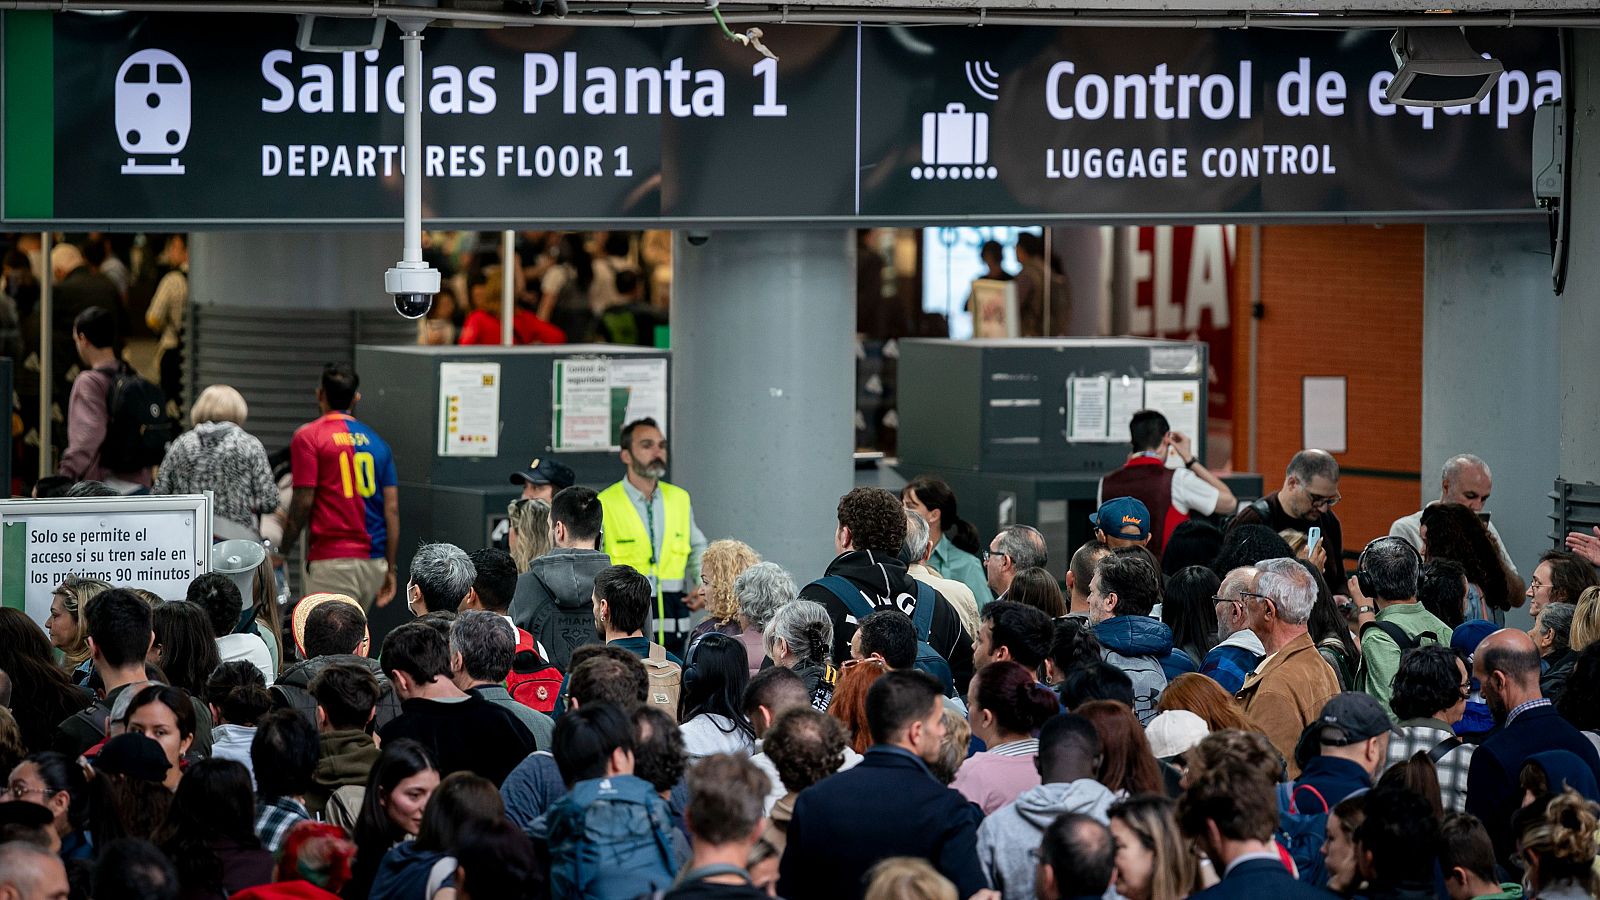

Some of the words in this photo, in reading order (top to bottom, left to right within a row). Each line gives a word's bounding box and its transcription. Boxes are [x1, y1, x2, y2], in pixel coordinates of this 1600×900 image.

[523, 51, 725, 117] Planta
[753, 57, 787, 117] 1
[1046, 60, 1252, 120] Control
[1277, 57, 1347, 117] de
[1368, 52, 1562, 129] epa
[261, 144, 486, 177] DEPARTRES
[497, 145, 604, 177] FLOOR
[614, 145, 633, 176] 1
[1046, 147, 1188, 179] LUGGAGE
[1201, 144, 1336, 178] CONTROL
[1129, 225, 1236, 335] ELA
[339, 450, 376, 498] 10
[31, 529, 58, 544] Solo
[62, 532, 76, 543] se
[80, 528, 131, 545] permite
[135, 528, 147, 542] el
[31, 549, 72, 563] acceso
[76, 549, 86, 562] si
[90, 550, 104, 562] su
[109, 549, 136, 562] tren
[140, 547, 167, 561] sale
[171, 549, 187, 561] en
[31, 570, 48, 584] los
[116, 568, 132, 581] 90
[136, 567, 190, 581] minutos
[557, 617, 594, 626] MIAM
